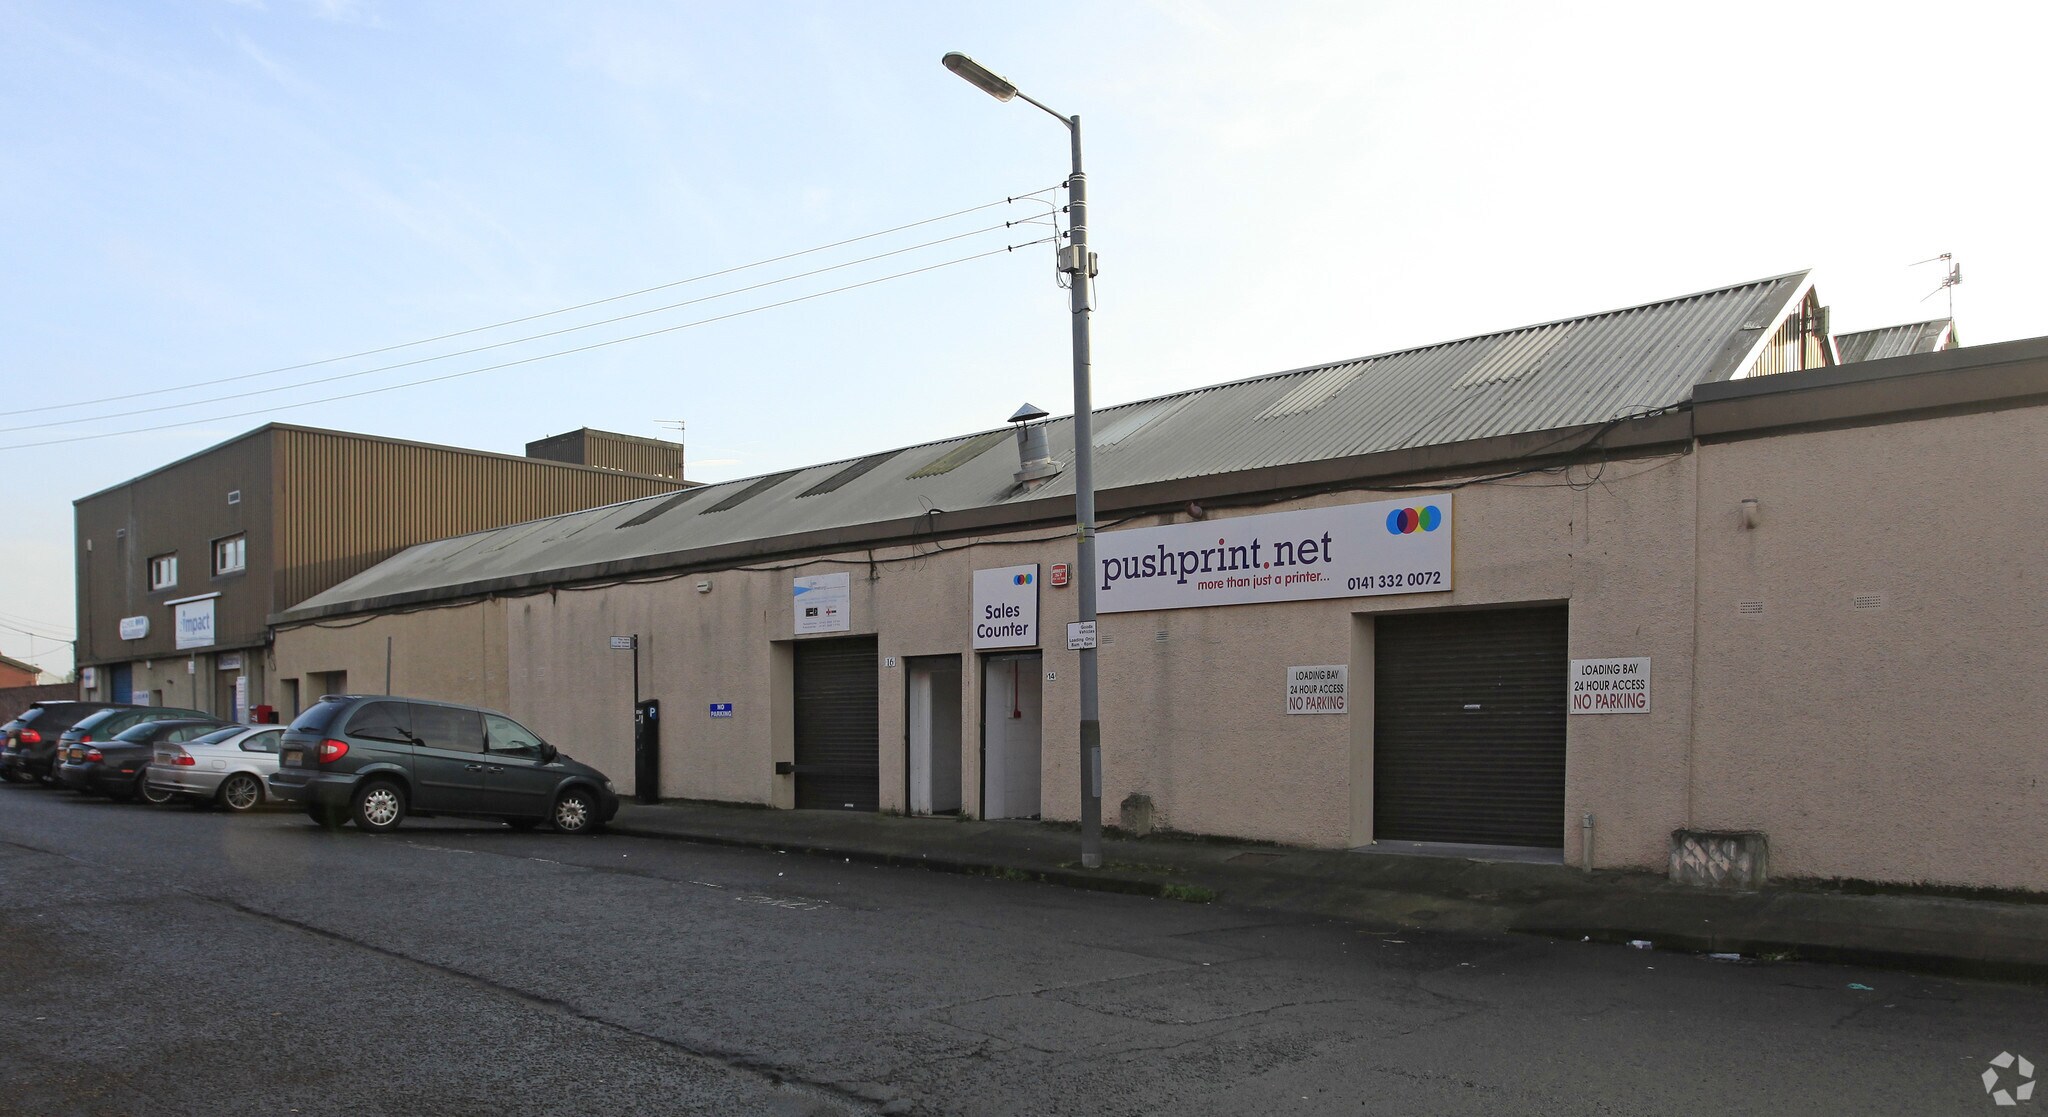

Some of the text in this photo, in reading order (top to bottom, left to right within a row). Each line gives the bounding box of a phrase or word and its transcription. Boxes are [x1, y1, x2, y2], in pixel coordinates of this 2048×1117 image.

[1101, 531, 1332, 591] pushprint.net
[1197, 572, 1330, 590] more than just a printer...
[1348, 571, 1441, 590] 0141 332 0072
[985, 603, 1020, 619] Sales
[977, 622, 1028, 638] Counter
[886, 658, 894, 666] 16
[1296, 670, 1339, 680] LOADING BAY
[1582, 663, 1639, 675] LOADING BAY
[1047, 672, 1055, 680] 14
[1290, 684, 1344, 694] 24 HOUR ACCESS
[1574, 679, 1645, 691] 24 HOUR ACCESS
[1289, 696, 1344, 710] NO PARKING
[1573, 693, 1646, 709] NO PARKING
[649, 707, 656, 717] P
